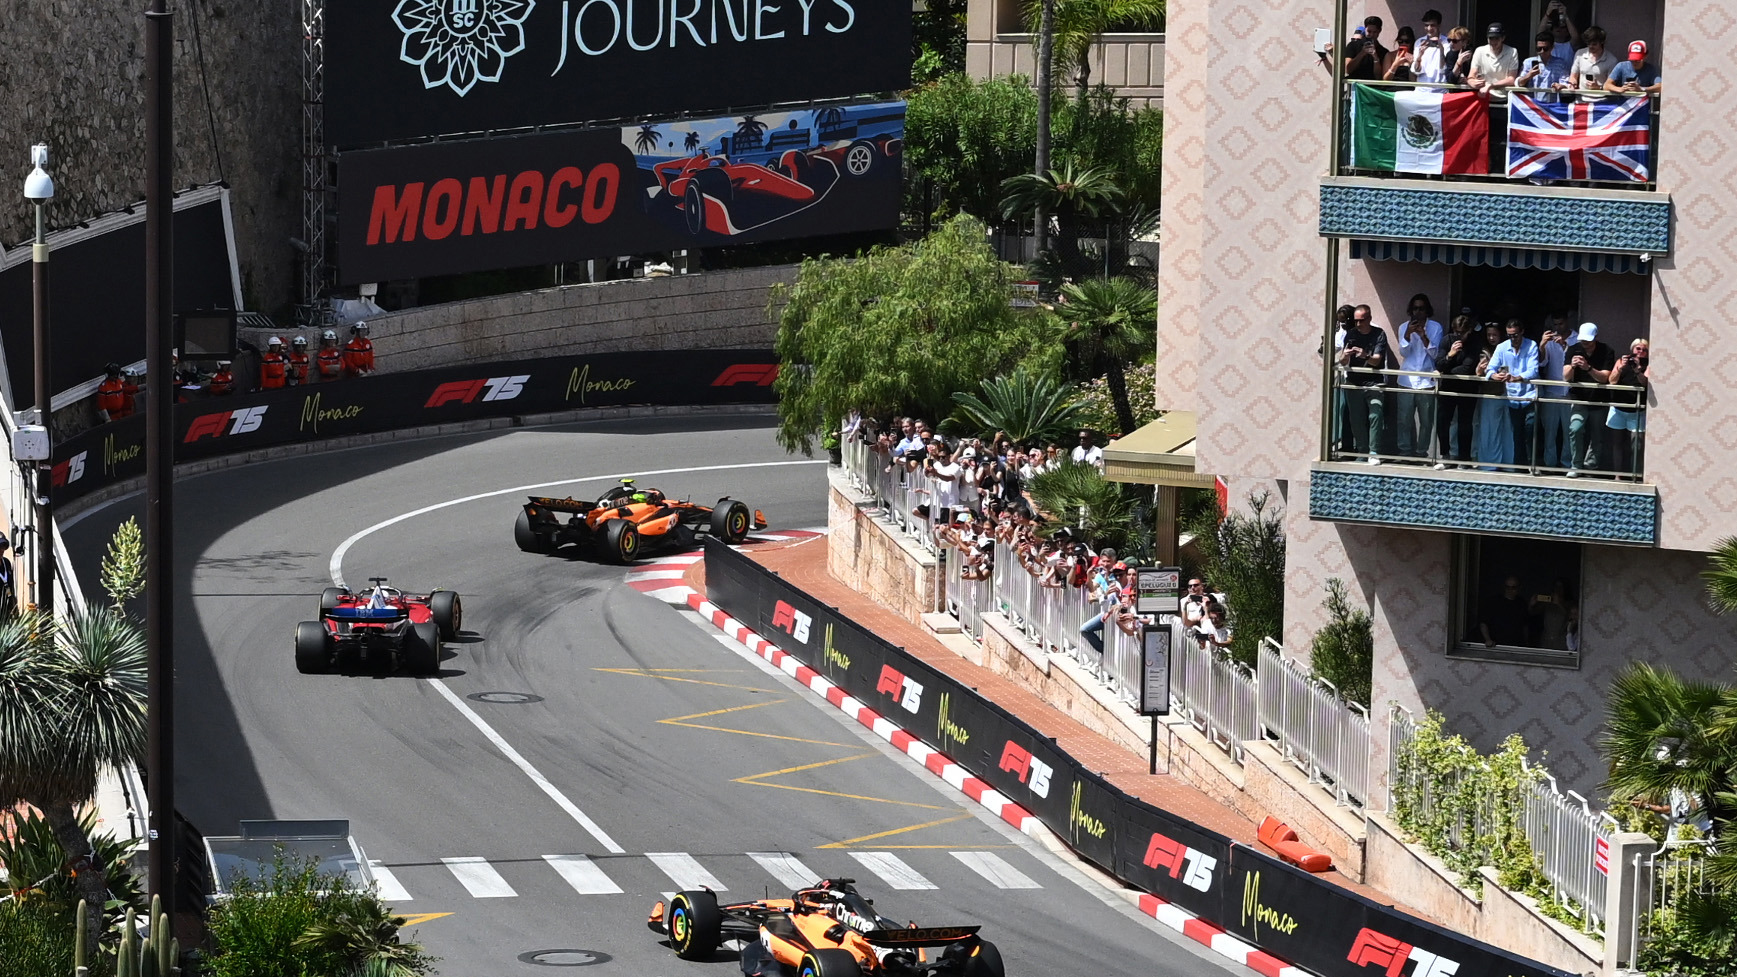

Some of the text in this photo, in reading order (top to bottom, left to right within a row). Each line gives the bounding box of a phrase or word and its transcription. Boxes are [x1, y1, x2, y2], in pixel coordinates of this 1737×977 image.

[366, 162, 620, 246] MONACO
[483, 374, 531, 402] 75
[566, 363, 636, 404] Monaco
[229, 405, 268, 435] 75
[300, 392, 364, 434] Monaco
[104, 432, 141, 476] Monaco
[823, 622, 851, 677] Monaco
[900, 675, 924, 715] 75
[937, 691, 970, 752] Monaco
[1029, 757, 1054, 800] 75
[1070, 779, 1106, 845] Monaco
[1179, 845, 1217, 893] 75
[835, 902, 875, 933] Chrome
[1241, 870, 1298, 942] Monaco
